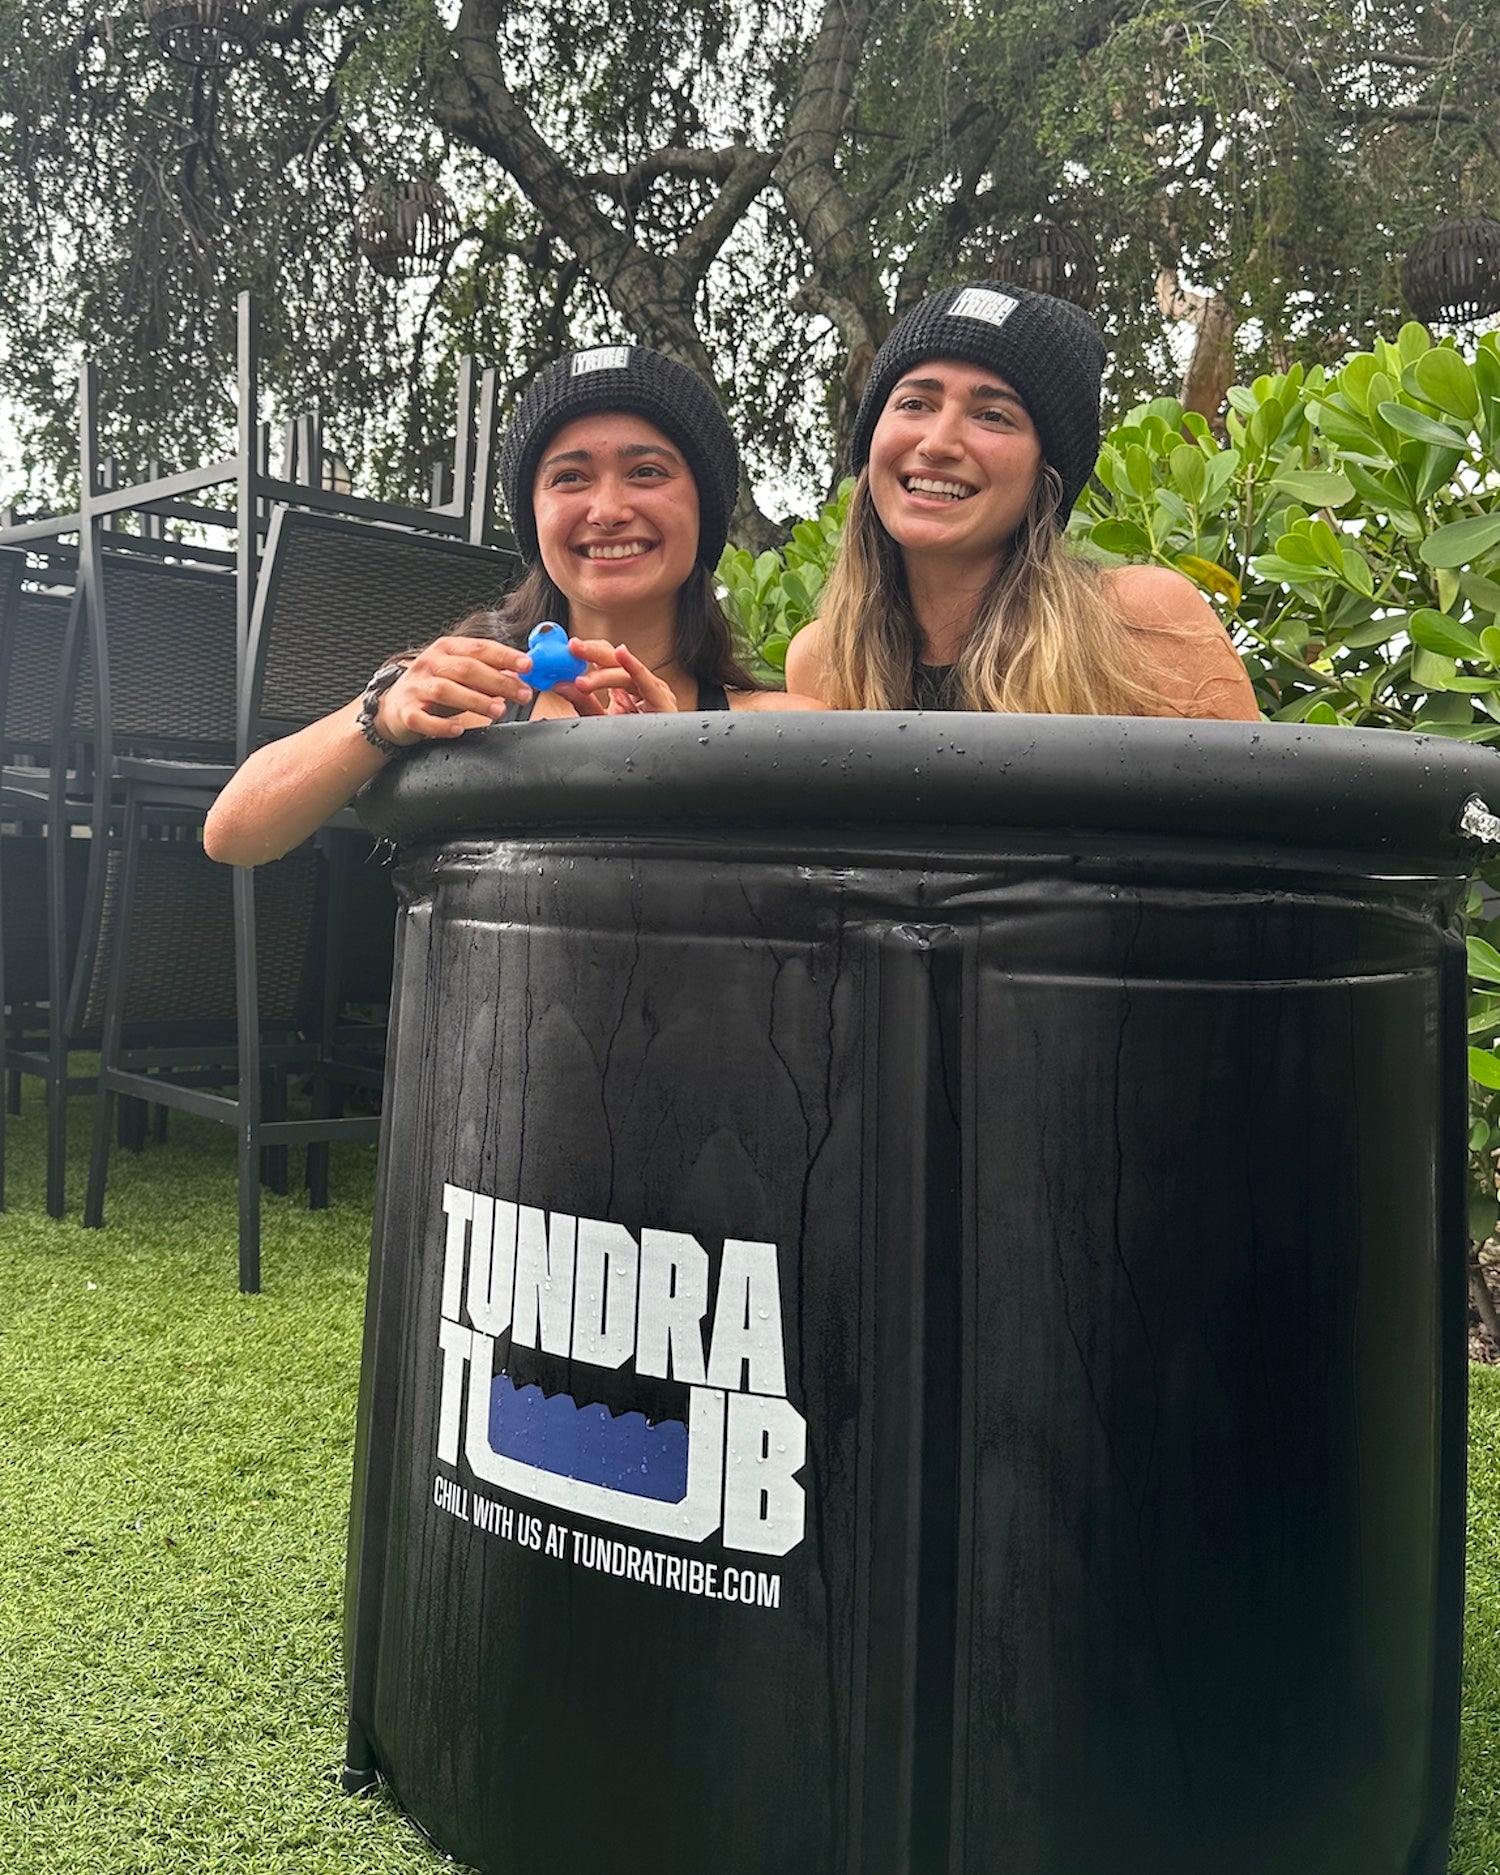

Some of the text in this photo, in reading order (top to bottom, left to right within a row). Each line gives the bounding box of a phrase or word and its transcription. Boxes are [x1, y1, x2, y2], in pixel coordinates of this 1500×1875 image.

[441, 1183, 787, 1397] TUNDRA
[433, 1475, 781, 1609] CHILL WITH US AT TUNDRATRIBE.COM
[437, 1317, 807, 1557] TUB
